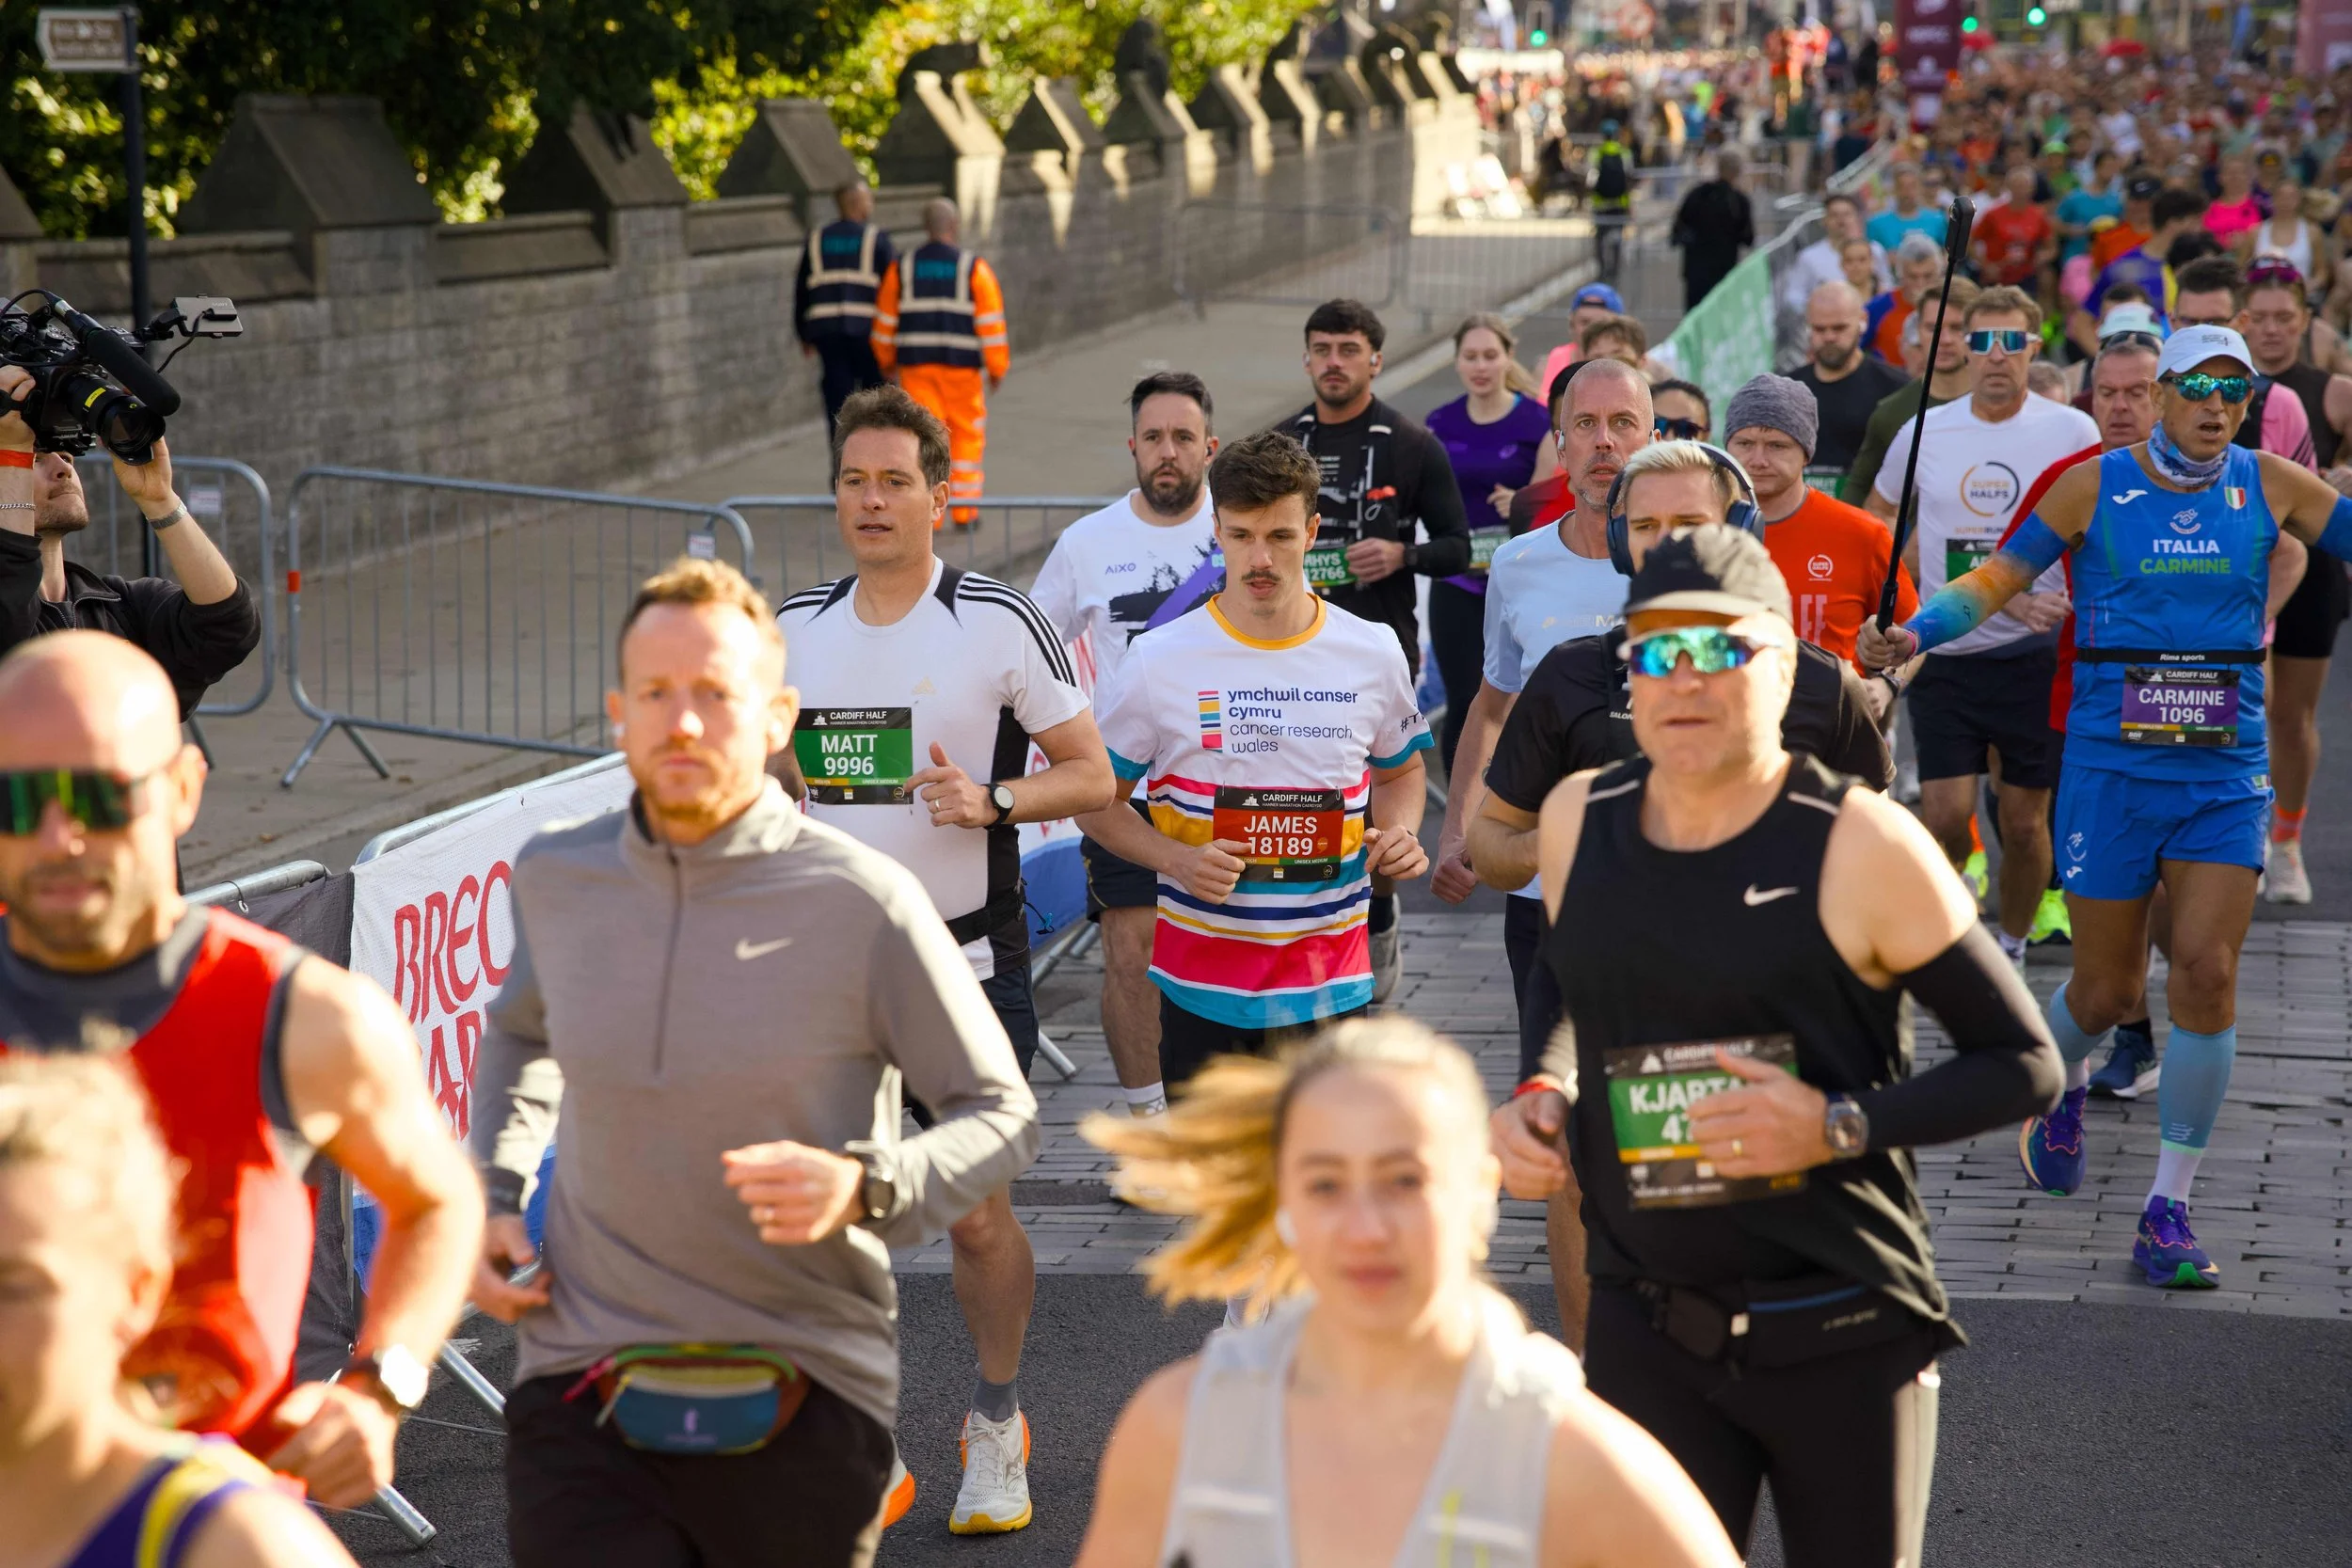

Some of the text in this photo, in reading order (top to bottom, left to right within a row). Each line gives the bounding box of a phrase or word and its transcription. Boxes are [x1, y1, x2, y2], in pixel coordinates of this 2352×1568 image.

[2153, 539, 2220, 553] ITALIA
[2139, 558, 2232, 574] CARMINE
[2182, 654, 2205, 662] sports
[1228, 688, 1359, 704] ymchwil canser
[2138, 688, 2225, 706] CARMINE
[830, 710, 887, 720] CARDIFF HALF
[1228, 705, 1282, 721] cymru
[2159, 706, 2206, 723] 1096
[1230, 723, 1353, 739] cancer research
[821, 734, 878, 753] MATT
[1232, 738, 1279, 753] wales
[824, 756, 874, 776] 9996
[1262, 793, 1323, 802] CARDIFF HALF
[1243, 815, 1318, 834] JAMES
[1248, 836, 1313, 856] 18189
